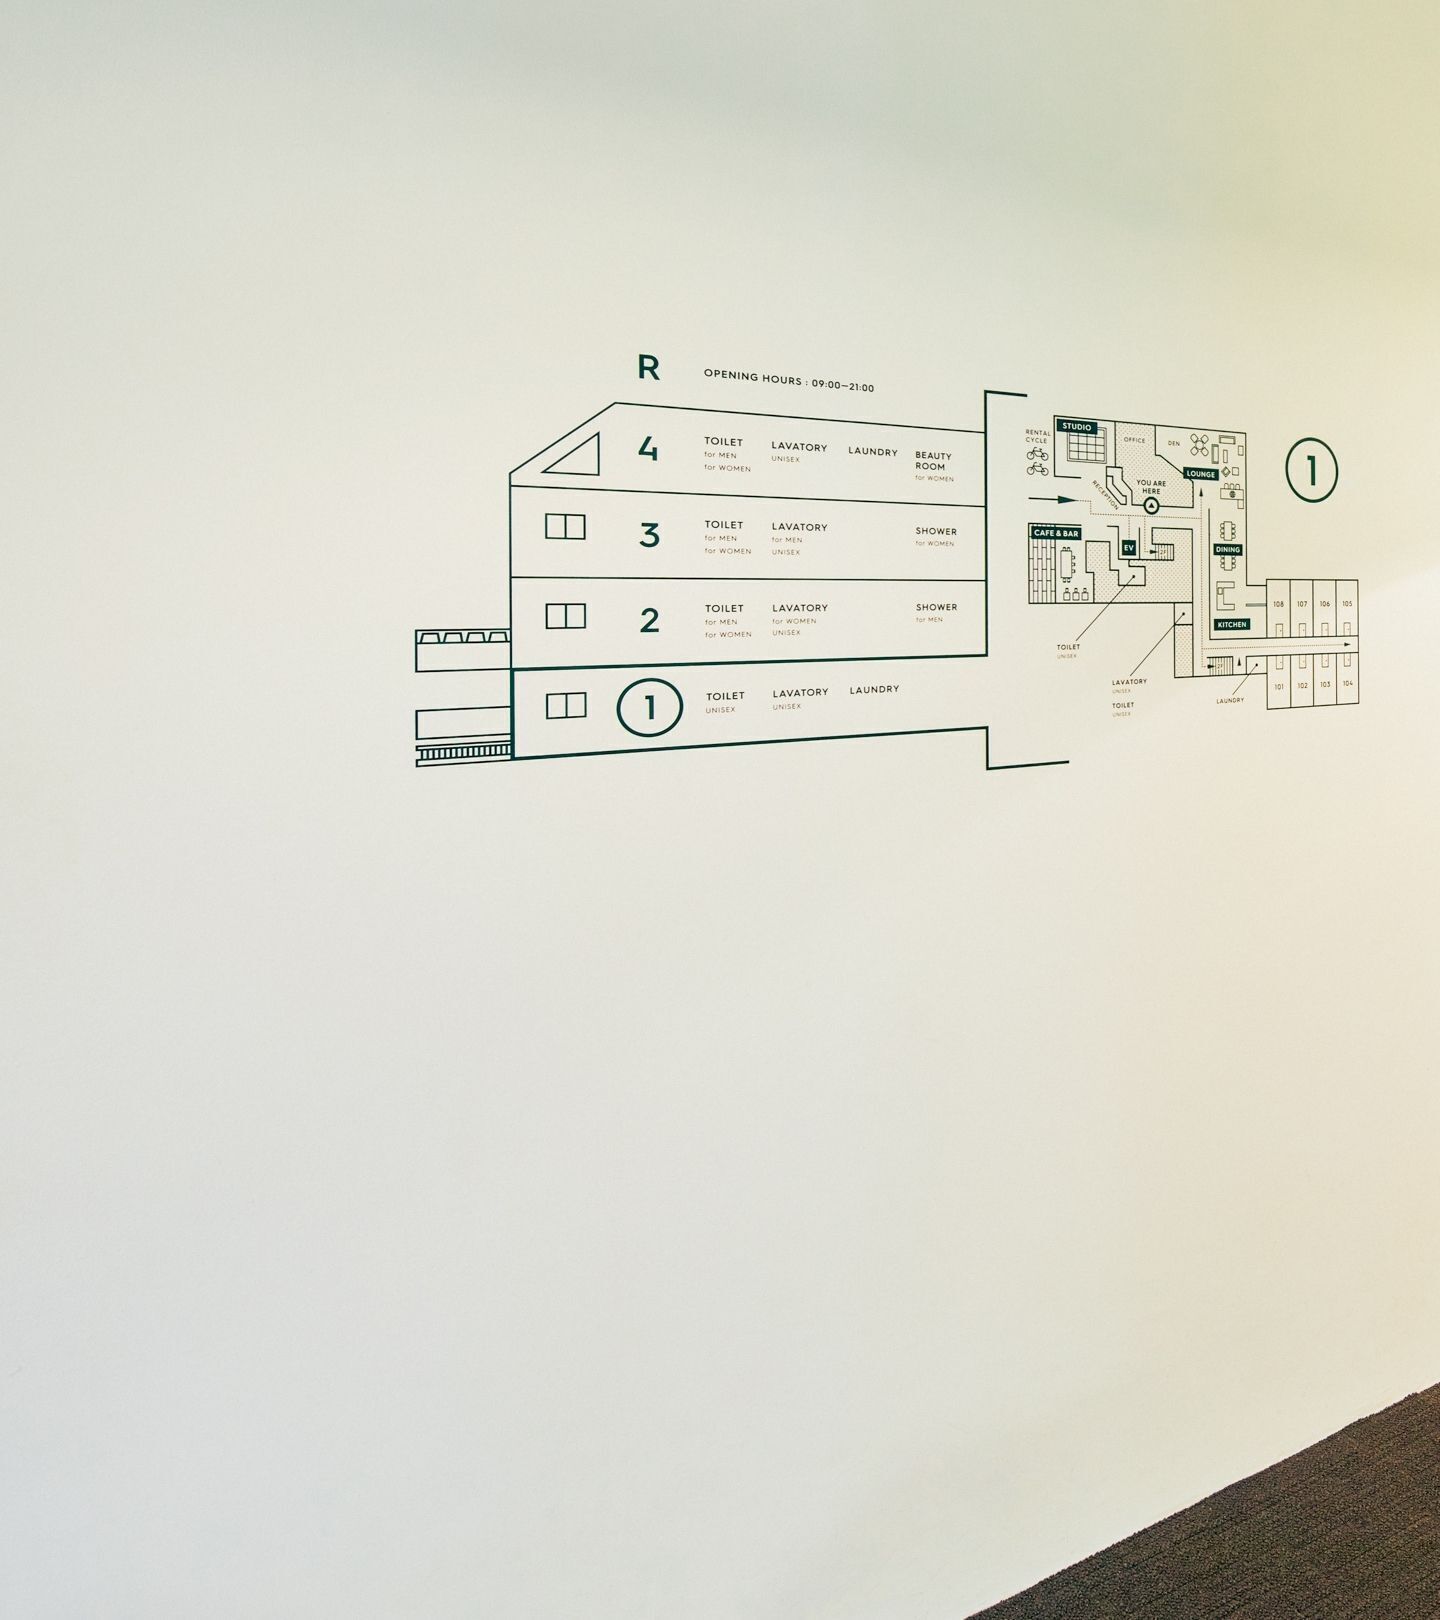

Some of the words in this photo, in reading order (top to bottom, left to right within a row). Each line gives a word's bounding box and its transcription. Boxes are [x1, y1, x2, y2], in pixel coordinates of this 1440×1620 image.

[639, 354, 660, 380] R
[704, 369, 758, 381] OPENING
[763, 375, 801, 385] HOURS
[1062, 422, 1092, 432] STUDIO
[1026, 429, 1051, 438] RENTAL
[704, 437, 743, 446] TOILET
[1025, 436, 1048, 445] CYCLE
[1123, 436, 1146, 444] OFFICE
[638, 436, 657, 461] 4
[772, 442, 827, 452] LAVATORY
[849, 447, 897, 456] LAUNDRY
[704, 450, 716, 458] for
[718, 451, 737, 459] MEN
[771, 455, 801, 463] UNISEX
[916, 451, 951, 460] BEAUTY
[704, 463, 716, 471] for
[718, 464, 751, 473] WOMEN
[915, 461, 946, 471] ROOM
[1307, 455, 1315, 486] 1
[927, 475, 955, 483] WOMEN
[1186, 470, 1216, 479] LOUNGE
[1136, 479, 1151, 487] YOU
[1092, 479, 1119, 511] RECEPTION
[1142, 487, 1161, 495] HERE
[705, 520, 743, 529] TOILET
[771, 522, 828, 532] LAVATORY
[640, 523, 659, 547] 3
[915, 526, 957, 536] SHOWER
[1033, 528, 1055, 538] CAFE
[1056, 529, 1064, 538] &
[1065, 530, 1079, 539] BAR
[704, 534, 717, 542] for
[785, 536, 803, 544] MEN
[704, 547, 716, 555] for
[719, 547, 752, 555] WOMEN
[771, 548, 801, 556] UNISEX
[1123, 543, 1135, 553] EV
[704, 604, 744, 613] TOILET
[772, 603, 828, 613] LAVATORY
[915, 603, 958, 612] SHOWER
[1273, 600, 1285, 608] 108
[1297, 600, 1308, 608] 107
[1319, 600, 1331, 608] 106
[1342, 600, 1353, 608] 105
[640, 608, 659, 632] 2
[719, 618, 738, 626] MEN
[786, 617, 817, 625] WOMEN
[915, 616, 926, 624] for
[1217, 620, 1248, 629] KITCHEN
[704, 631, 717, 639] for
[772, 628, 801, 637] UNISEX
[1056, 643, 1081, 651] TOILET
[1111, 678, 1148, 686] LAVATORY
[1320, 680, 1331, 688] 103
[850, 685, 899, 694] LAUNDRY
[1274, 683, 1284, 691] 101
[705, 691, 745, 701] TOILET
[773, 688, 828, 698] LAVATORY
[1112, 701, 1135, 709] TOILET
[1216, 697, 1245, 705] LAUNDRY
[645, 695, 654, 720] 1
[705, 706, 736, 715] UNISEX
[772, 702, 801, 711] UNISEX
